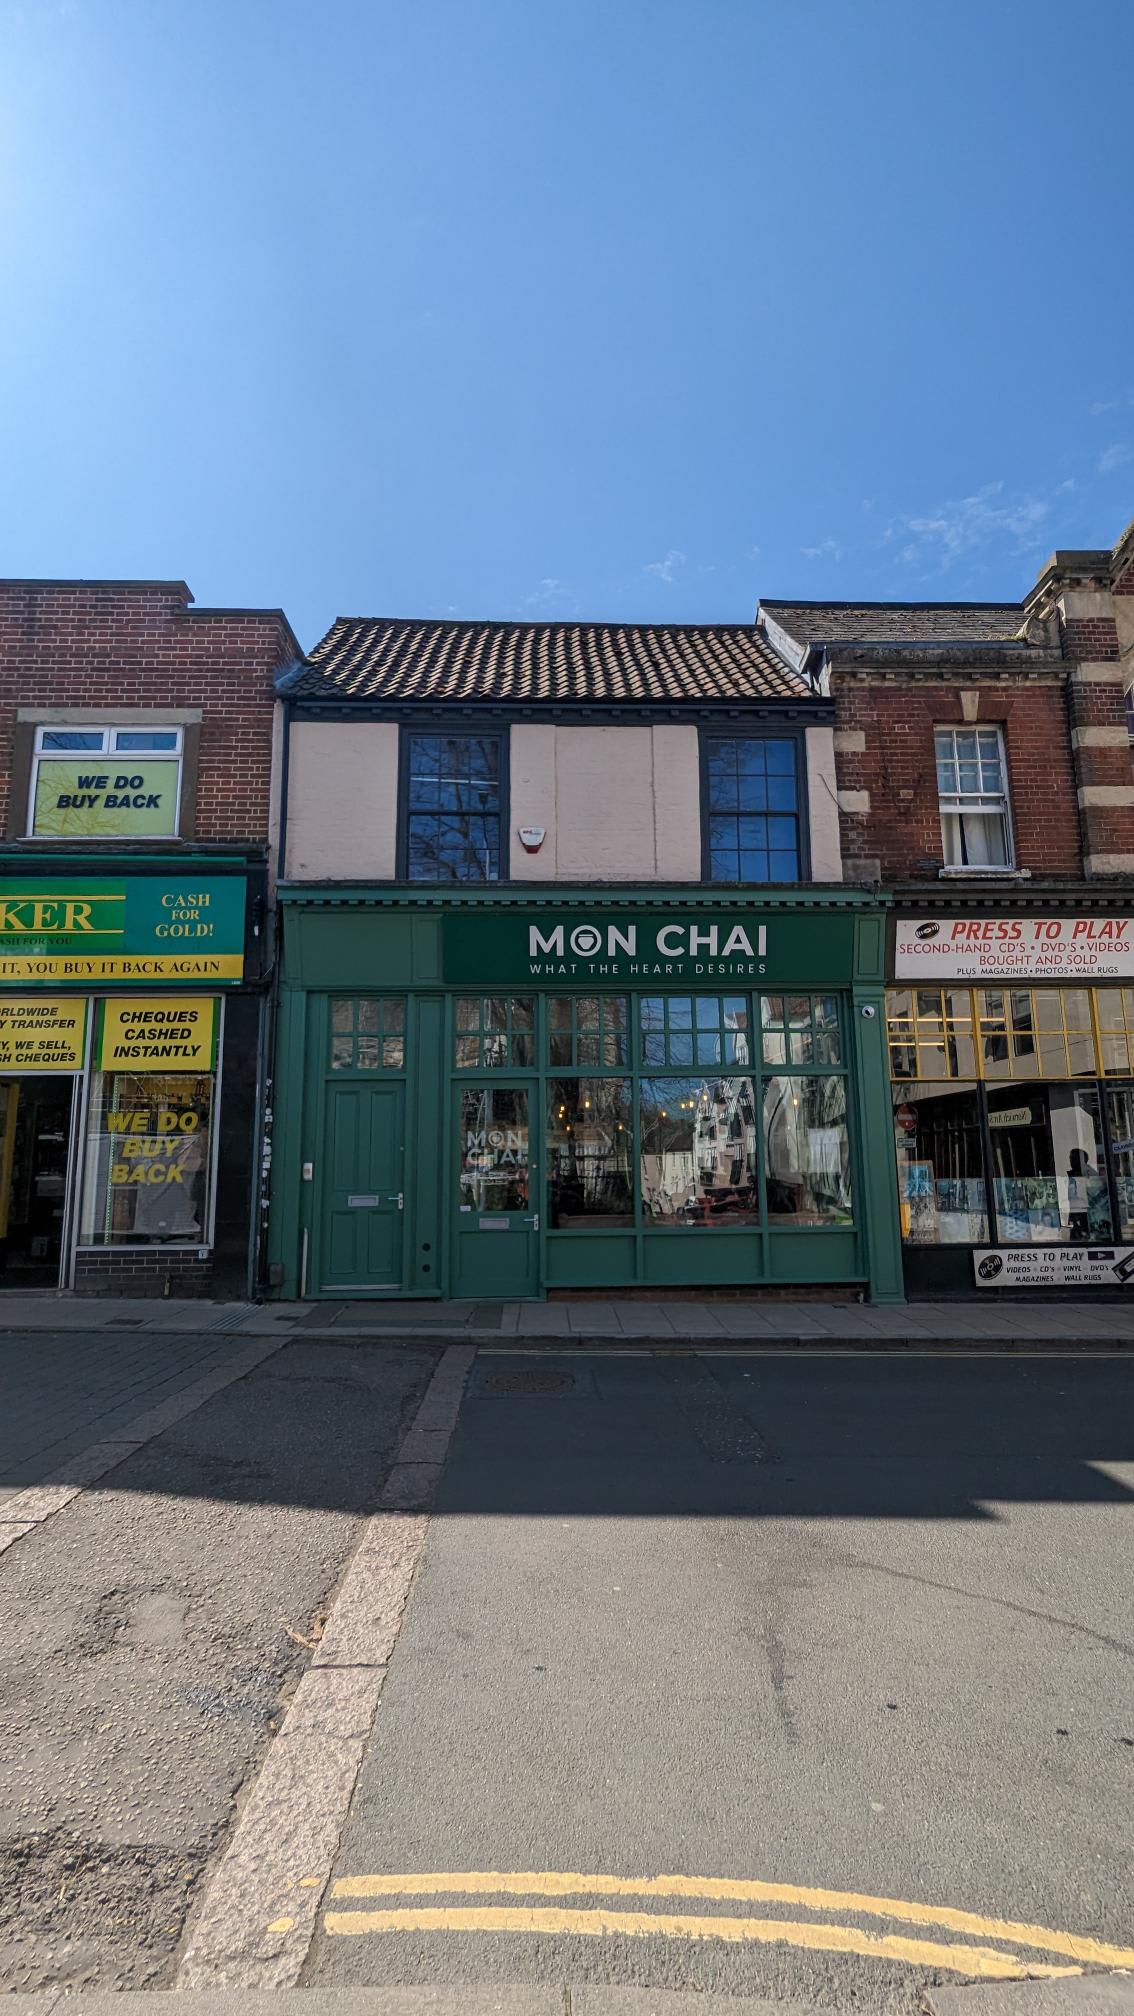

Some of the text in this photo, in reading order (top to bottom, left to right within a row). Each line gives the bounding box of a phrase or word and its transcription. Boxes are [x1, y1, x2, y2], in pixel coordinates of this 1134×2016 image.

[77, 775, 144, 789] WE DO
[56, 794, 162, 809] BUY BACK
[161, 894, 210, 907] CASH
[0, 902, 95, 930] KER
[171, 910, 200, 920] FOR
[155, 923, 214, 937] GOLD!
[950, 920, 1129, 941] PRESS TO PLAY
[23, 937, 45, 945] FOR
[49, 937, 73, 945] YOU
[529, 924, 767, 957] MON CHAI
[899, 941, 1130, 954] SECOND-HAND CD'S DVD'S VIDEOS
[979, 954, 1098, 966] BOUGHT AND SOLD
[2, 961, 221, 976] IT, YOU BUY IT BACK AGAIN
[529, 963, 767, 974] WHAT THE HEART DESIRES
[957, 966, 1119, 975] PLUS MAGAZINES PHOTOS WALL RUGS
[10, 1019, 76, 1029] TRANSFER
[119, 1011, 199, 1024] CHEQUES
[124, 1028, 192, 1041] CASHED
[0, 1040, 71, 1052] Y, WE SELL,
[113, 1045, 202, 1058] INSTANTLY
[15, 1053, 76, 1063] CHEQUES
[106, 1111, 199, 1132] WE DO
[467, 1130, 522, 1147] MON
[122, 1137, 181, 1158] BUY
[467, 1148, 523, 1164] CHAI
[111, 1163, 186, 1184] BACK
[1007, 1251, 1085, 1262] PRESS TO PLAY
[1015, 1275, 1054, 1283] MAGAZINES
